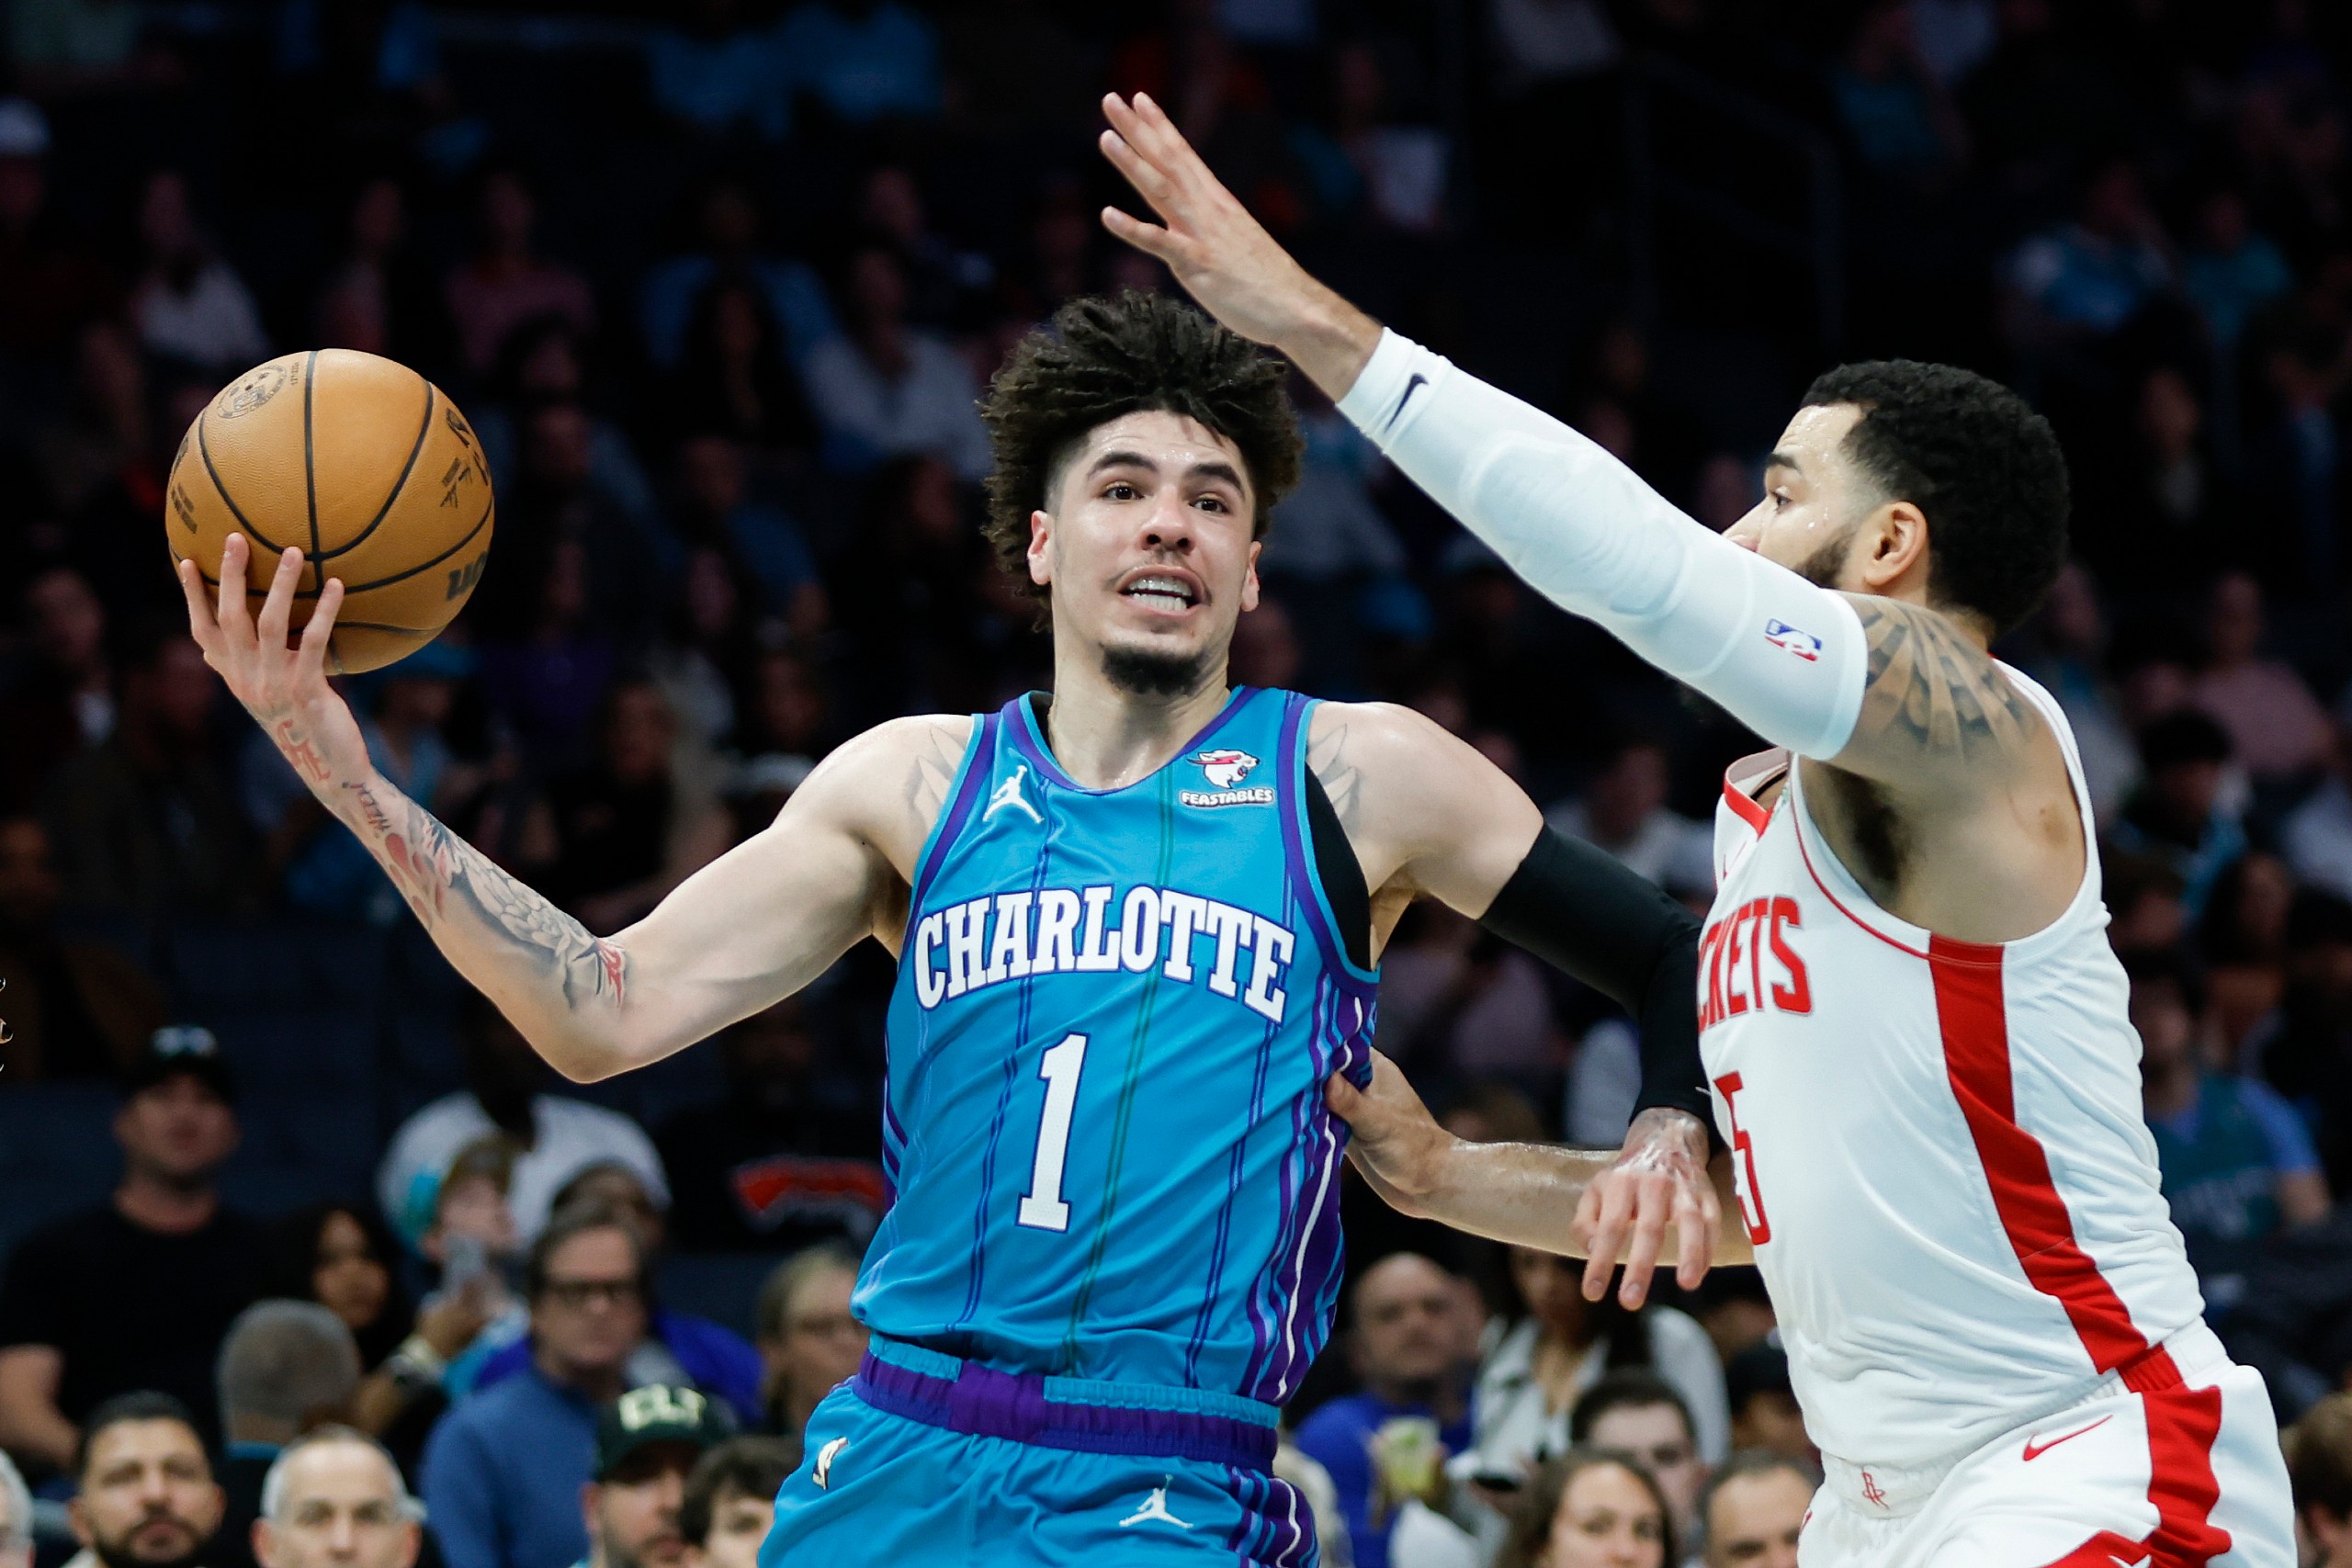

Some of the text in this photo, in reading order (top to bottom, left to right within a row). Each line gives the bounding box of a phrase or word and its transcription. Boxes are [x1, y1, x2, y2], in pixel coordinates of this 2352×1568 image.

[1180, 787, 1274, 807] FEASTABLES
[913, 885, 1295, 1025] CHARLOTTE
[1014, 1029, 1091, 1234] 1
[1713, 1070, 1771, 1246] 5
